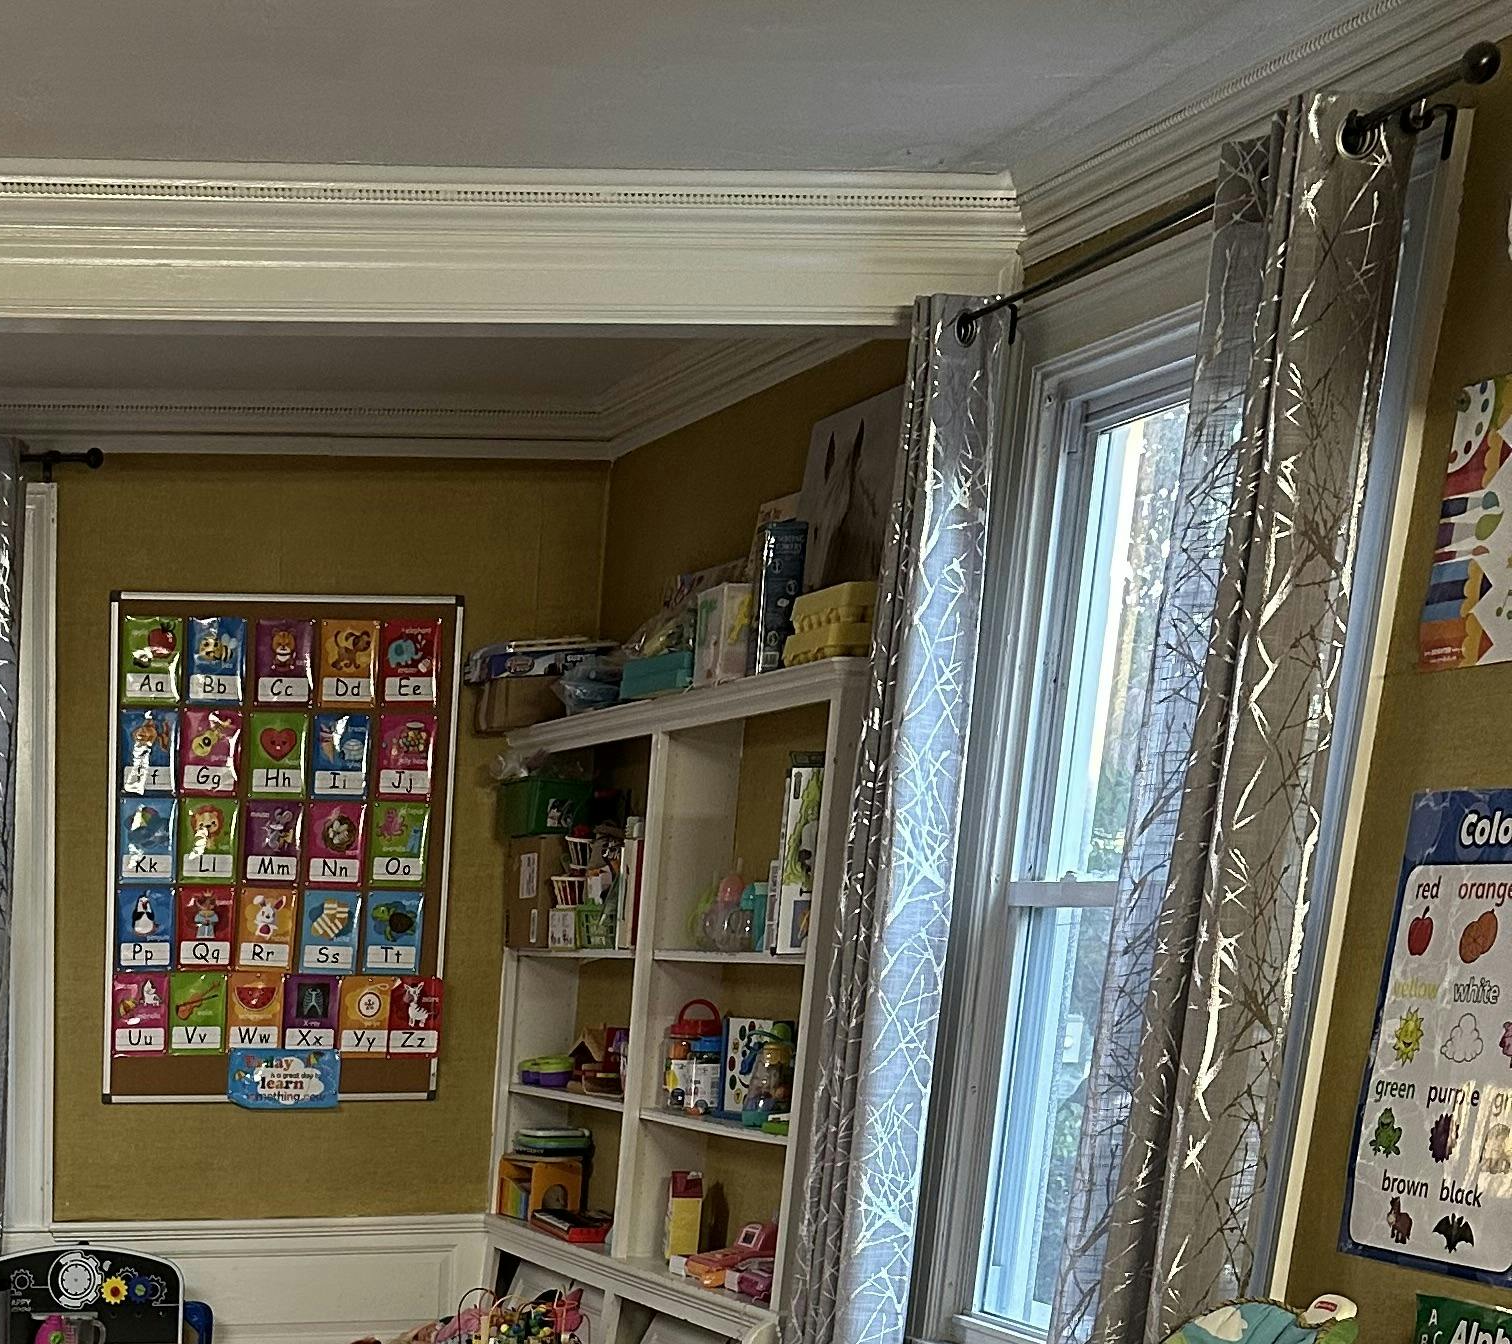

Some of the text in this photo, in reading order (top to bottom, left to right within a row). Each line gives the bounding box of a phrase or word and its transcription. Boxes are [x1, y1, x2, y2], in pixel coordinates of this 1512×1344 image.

[139, 676, 165, 693] Aa
[203, 677, 226, 694] Bb
[271, 678, 293, 697] Cc
[336, 678, 361, 697] Dd
[398, 677, 422, 696] Ee
[197, 766, 221, 789] Gg
[265, 769, 291, 787] Hh
[329, 771, 347, 789] Ii
[392, 771, 413, 793] Jj
[135, 857, 158, 873] Kk
[199, 856, 216, 873] Ll
[257, 857, 290, 875] Mm
[321, 859, 348, 877] Nn
[385, 858, 411, 875] Oo
[1416, 875, 1442, 900] red
[133, 942, 154, 962] Pp
[192, 942, 220, 964] Qq
[252, 943, 274, 960] Rr
[317, 947, 340, 964] Ss
[381, 946, 403, 963] Tt
[1393, 977, 1438, 1000] yellow
[1453, 977, 1500, 1005] white
[128, 1028, 153, 1046] Uu
[185, 1026, 207, 1044] Vv
[238, 1027, 271, 1045] Ww
[298, 1029, 323, 1047] Xx
[353, 1030, 376, 1051] Yy
[401, 1031, 427, 1048] Zz
[260, 1076, 304, 1090] learn
[1374, 1080, 1415, 1103] green
[1382, 1169, 1428, 1198] brown
[1439, 1179, 1483, 1207] black
[1428, 1308, 1438, 1326] A
